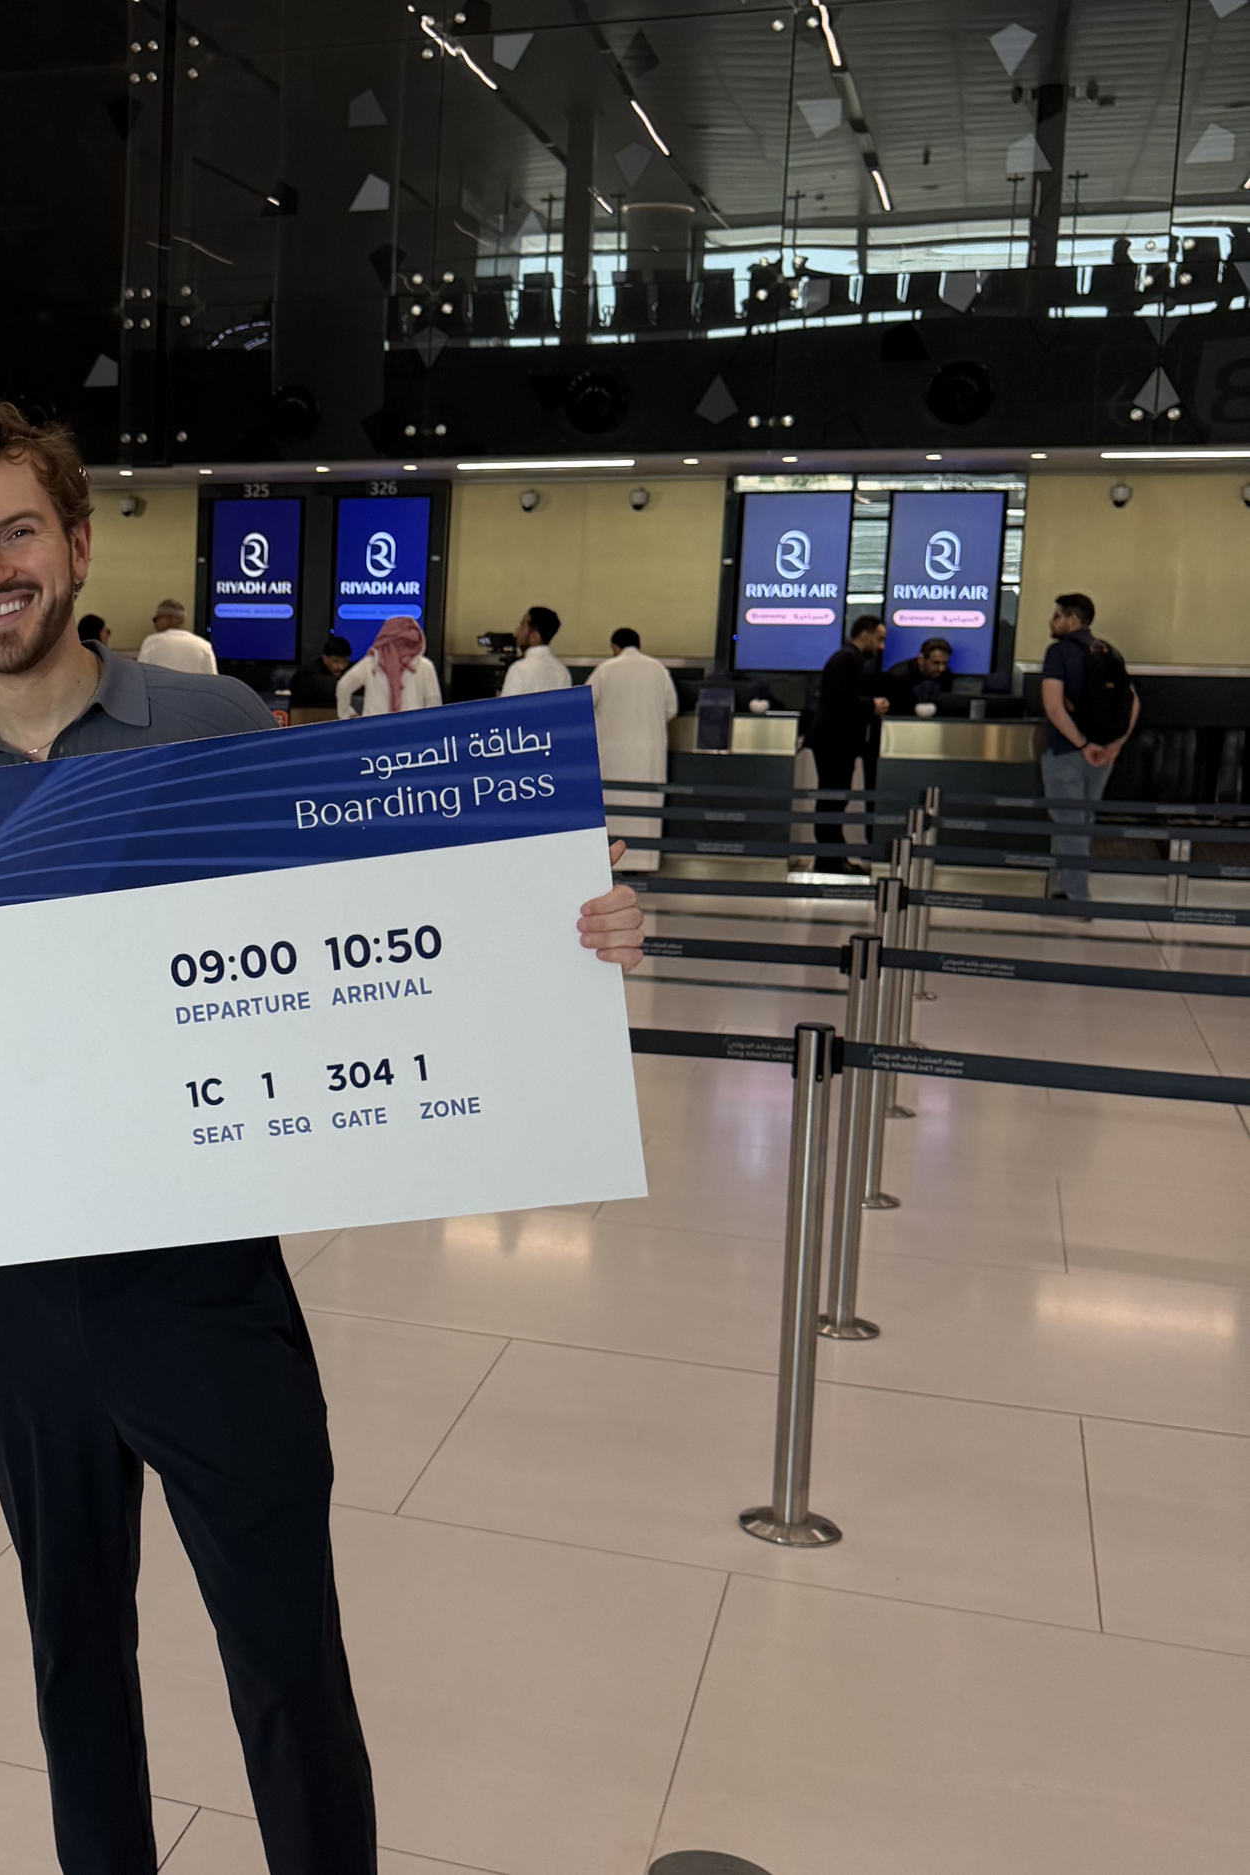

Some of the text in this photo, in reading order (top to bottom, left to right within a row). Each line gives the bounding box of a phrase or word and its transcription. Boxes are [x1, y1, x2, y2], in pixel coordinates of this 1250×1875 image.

[243, 484, 270, 498] 325
[370, 481, 398, 496] 326
[216, 581, 292, 594] RIYADH AIR
[340, 581, 420, 595] RIYADH AIR
[745, 583, 838, 598] RIYADH AIR
[893, 584, 989, 600] RIYADH AIR
[360, 726, 552, 780] بطاقة الصعود
[295, 774, 555, 830] Boarding Pass
[170, 924, 442, 987] 09:00 10:50
[175, 977, 432, 1025] DEPARTURE ARRIVAL
[185, 1053, 428, 1108] 1C 1 304 1
[192, 1097, 481, 1145] SEAT SEQ GATE ZONE
